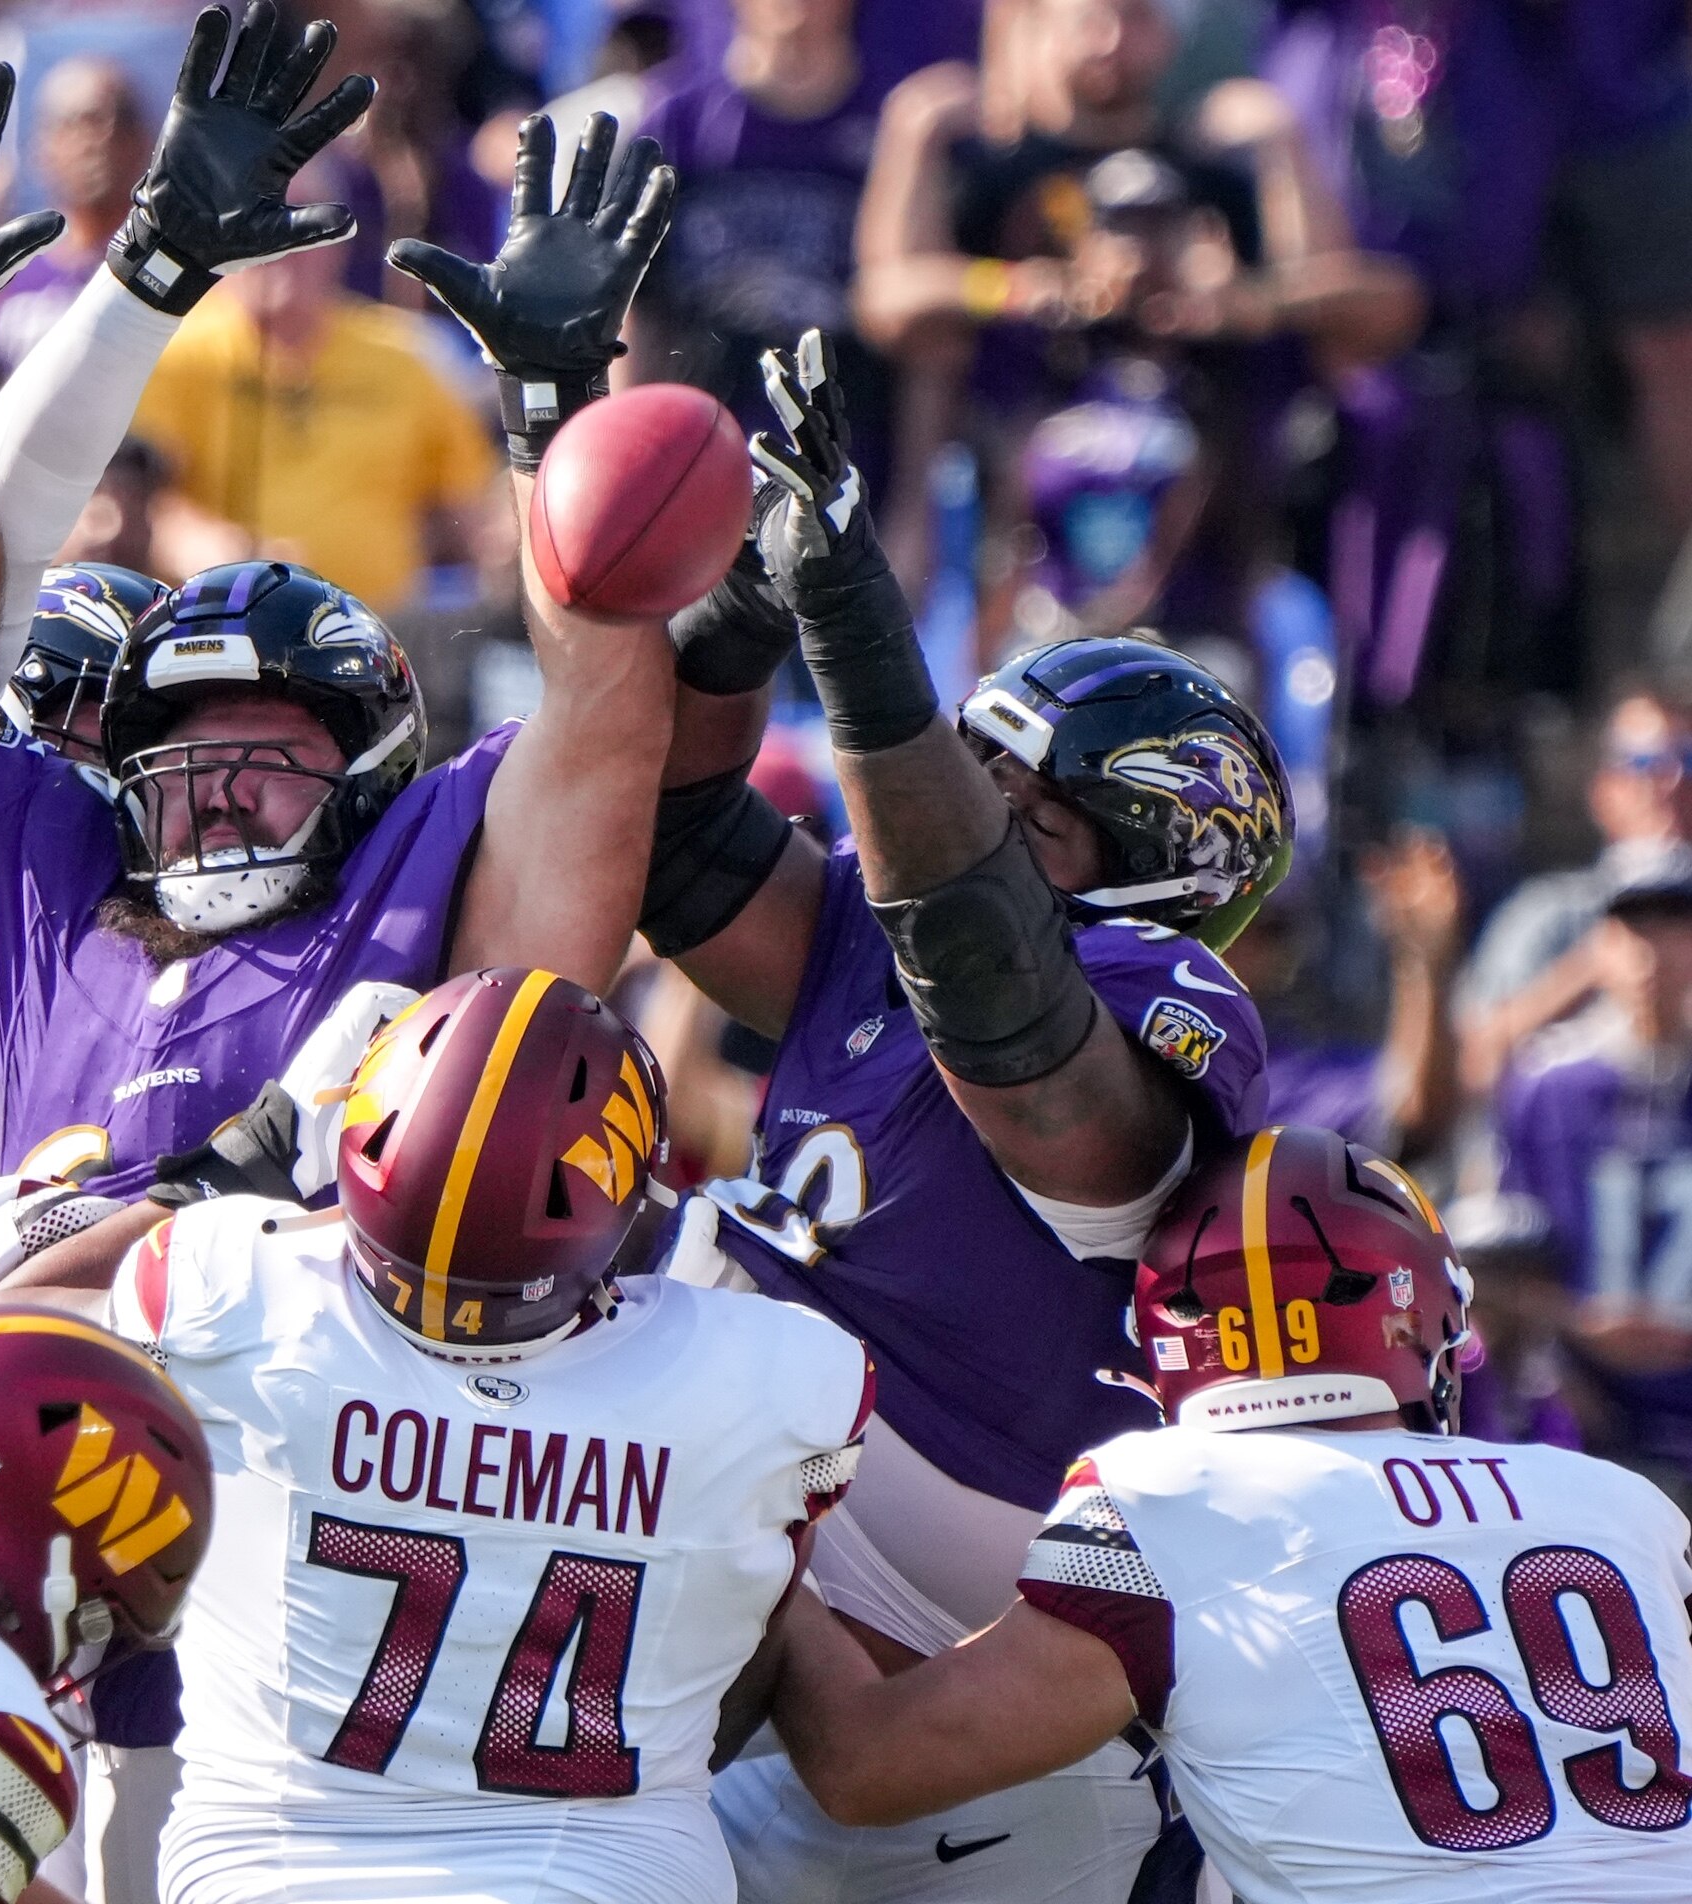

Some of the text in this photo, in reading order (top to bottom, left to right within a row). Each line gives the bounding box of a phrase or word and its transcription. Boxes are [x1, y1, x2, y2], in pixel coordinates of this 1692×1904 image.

[143, 274, 162, 293] 4XL
[530, 409, 553, 420] 4XL
[174, 640, 226, 656] RAVENS
[1162, 1004, 1217, 1041] RAVENS
[112, 1067, 202, 1104] RAVENS
[526, 1283, 551, 1298] NFL
[1207, 1390, 1353, 1418] WASHINGTON
[331, 1399, 672, 1538] COLEMAN
[1383, 1457, 1524, 1528] OTT
[305, 1510, 647, 1801] 74
[1337, 1545, 1692, 1852] 69
